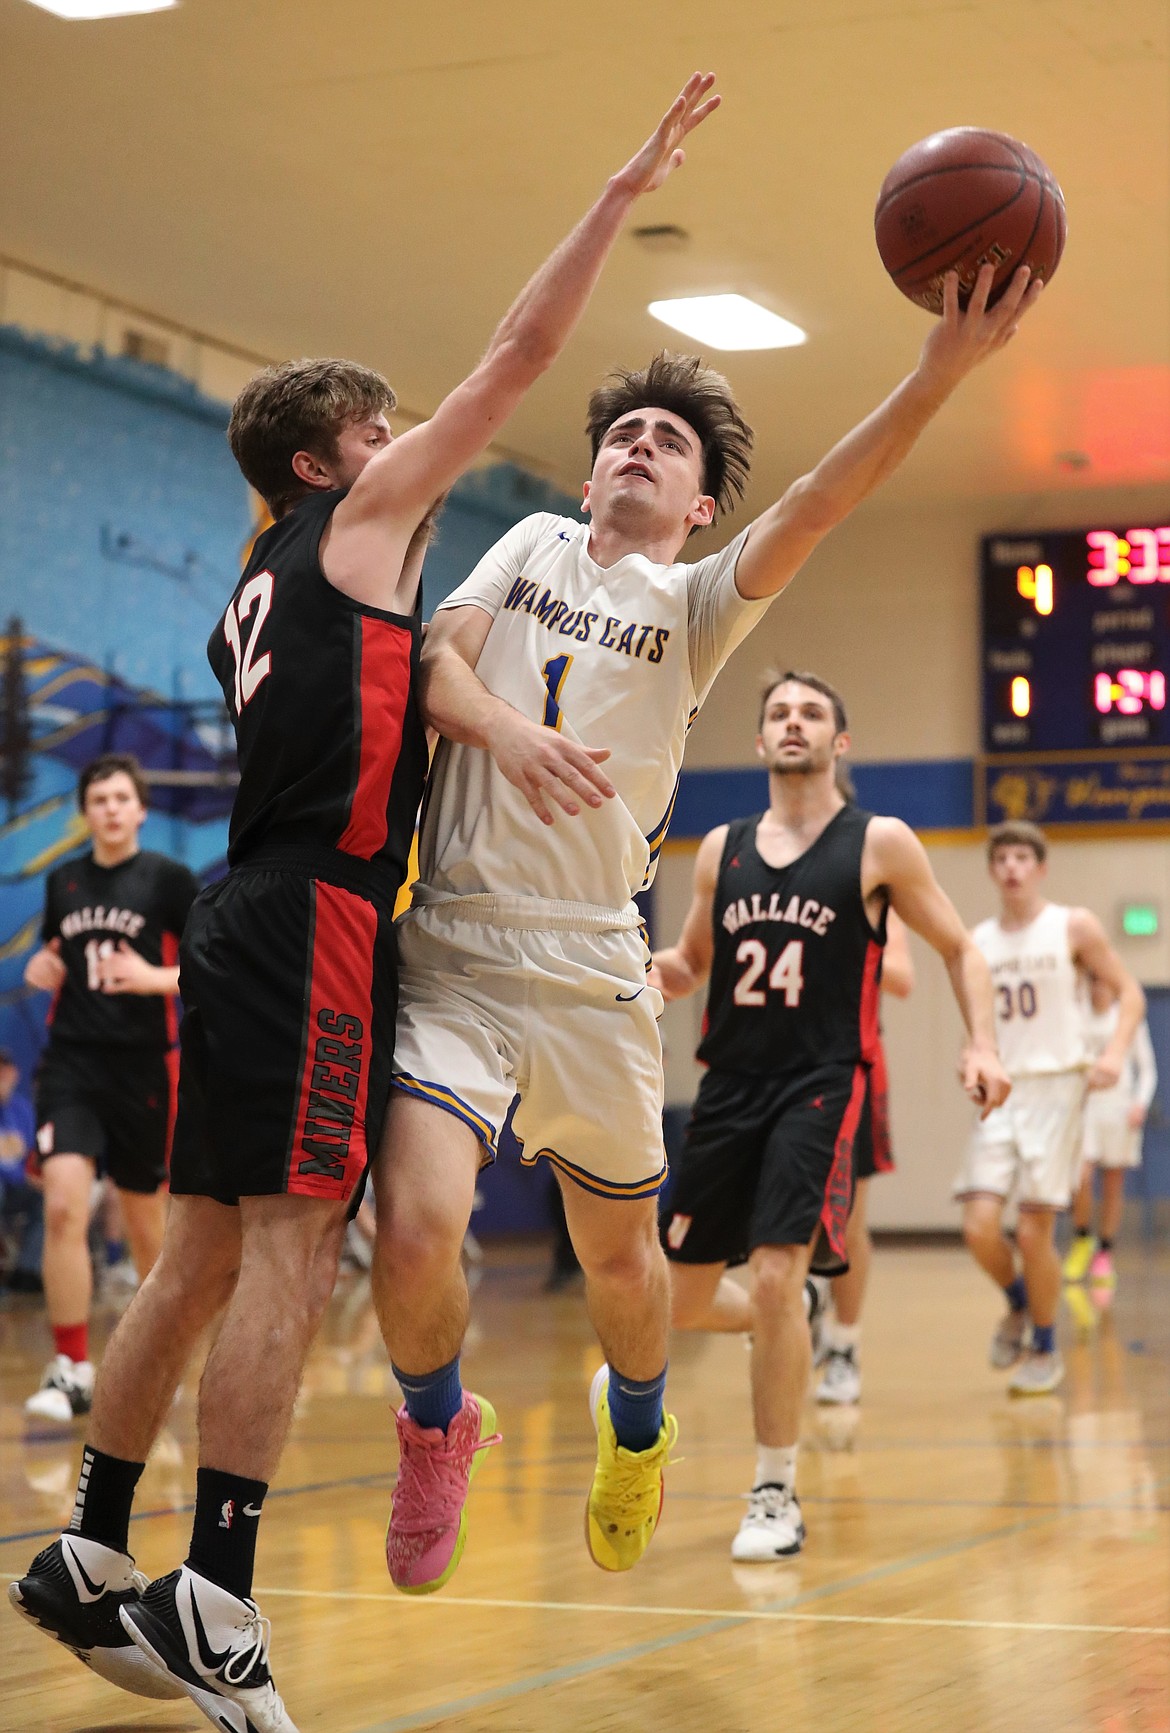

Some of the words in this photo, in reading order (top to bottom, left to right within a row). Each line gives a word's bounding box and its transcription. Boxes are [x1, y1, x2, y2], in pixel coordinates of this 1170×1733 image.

[1017, 564, 1053, 615] 4
[1086, 527, 1170, 587] 3:3
[223, 568, 275, 717] 12
[503, 576, 599, 643] WAMPUS
[598, 616, 670, 664] CATS
[541, 652, 575, 733] 1
[722, 893, 837, 937] WALLACE
[733, 938, 804, 1008] 24
[298, 1008, 364, 1181] MINERS
